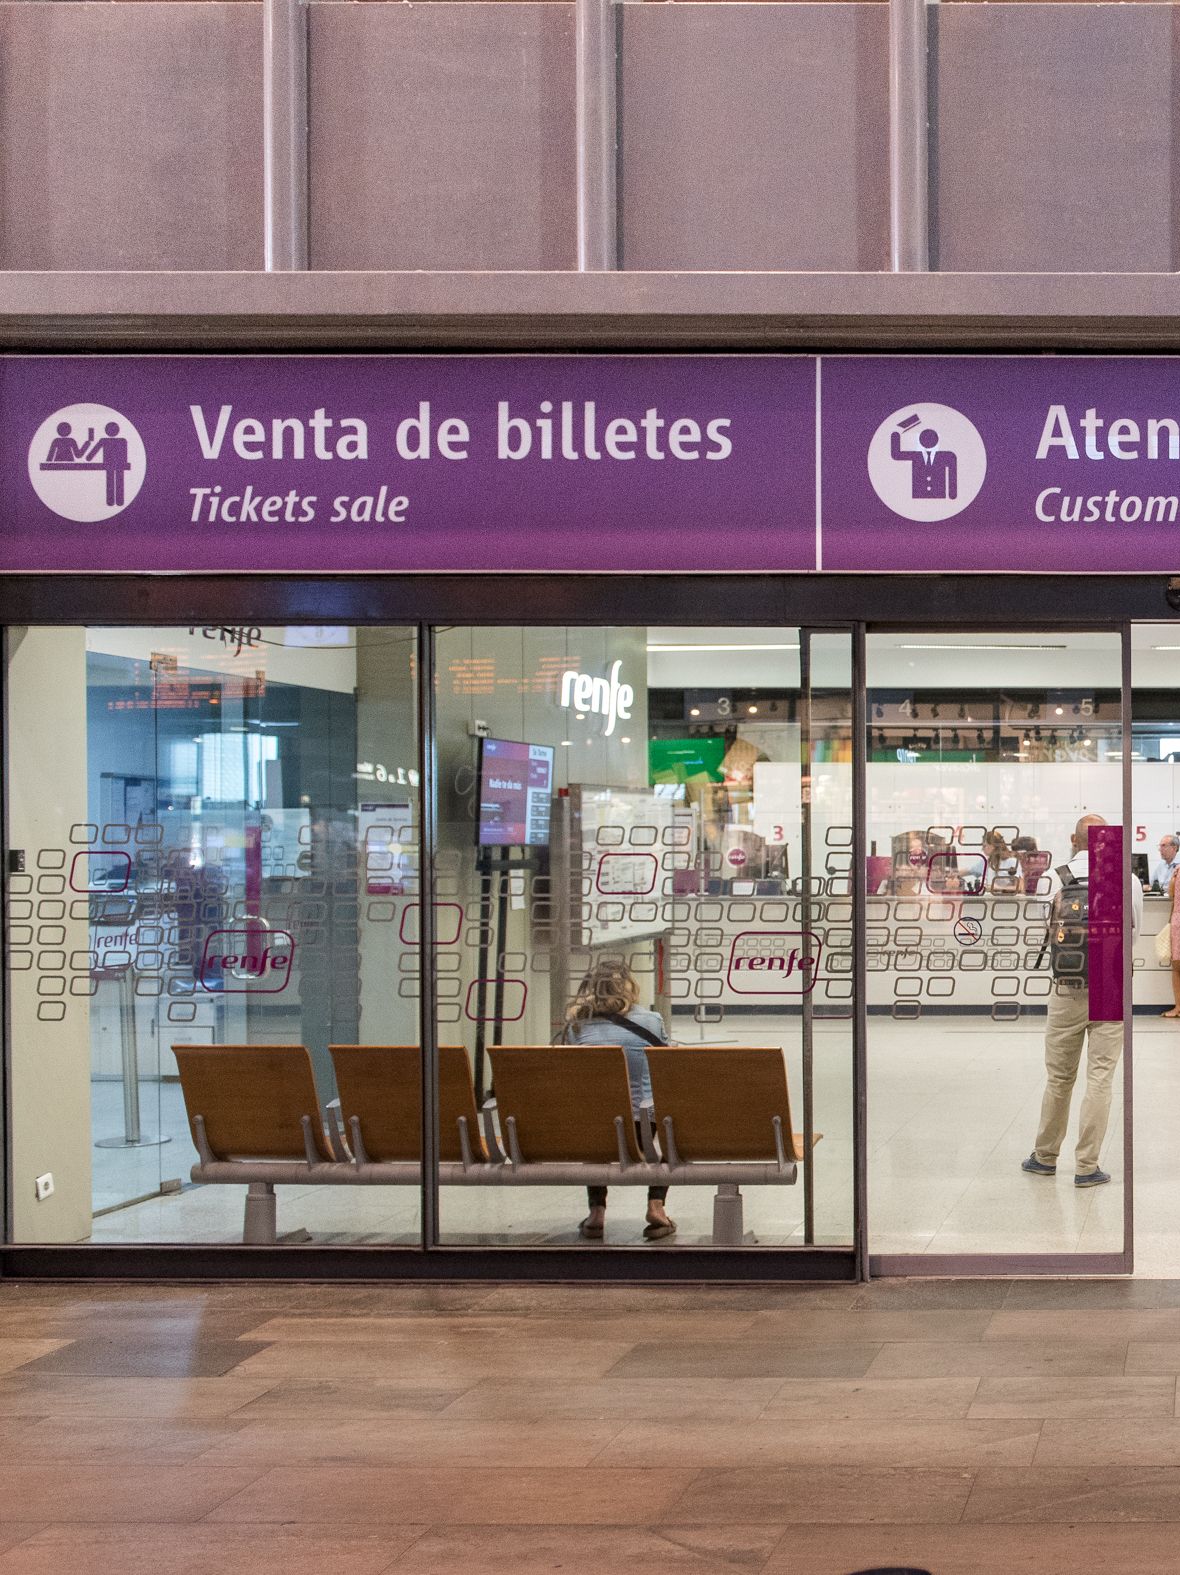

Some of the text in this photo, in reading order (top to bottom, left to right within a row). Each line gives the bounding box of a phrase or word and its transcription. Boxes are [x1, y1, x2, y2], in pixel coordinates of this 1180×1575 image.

[190, 402, 732, 460] Venta de billetes
[189, 486, 409, 522] Tickets sale
[561, 660, 633, 737] renfe
[718, 697, 730, 716] 3
[898, 699, 913, 716] 4
[1080, 698, 1093, 716] 5
[773, 826, 784, 842] 3
[1136, 826, 1147, 841] 5
[96, 926, 138, 952] renfe
[207, 946, 289, 977] renfe
[734, 947, 816, 979] renfe
